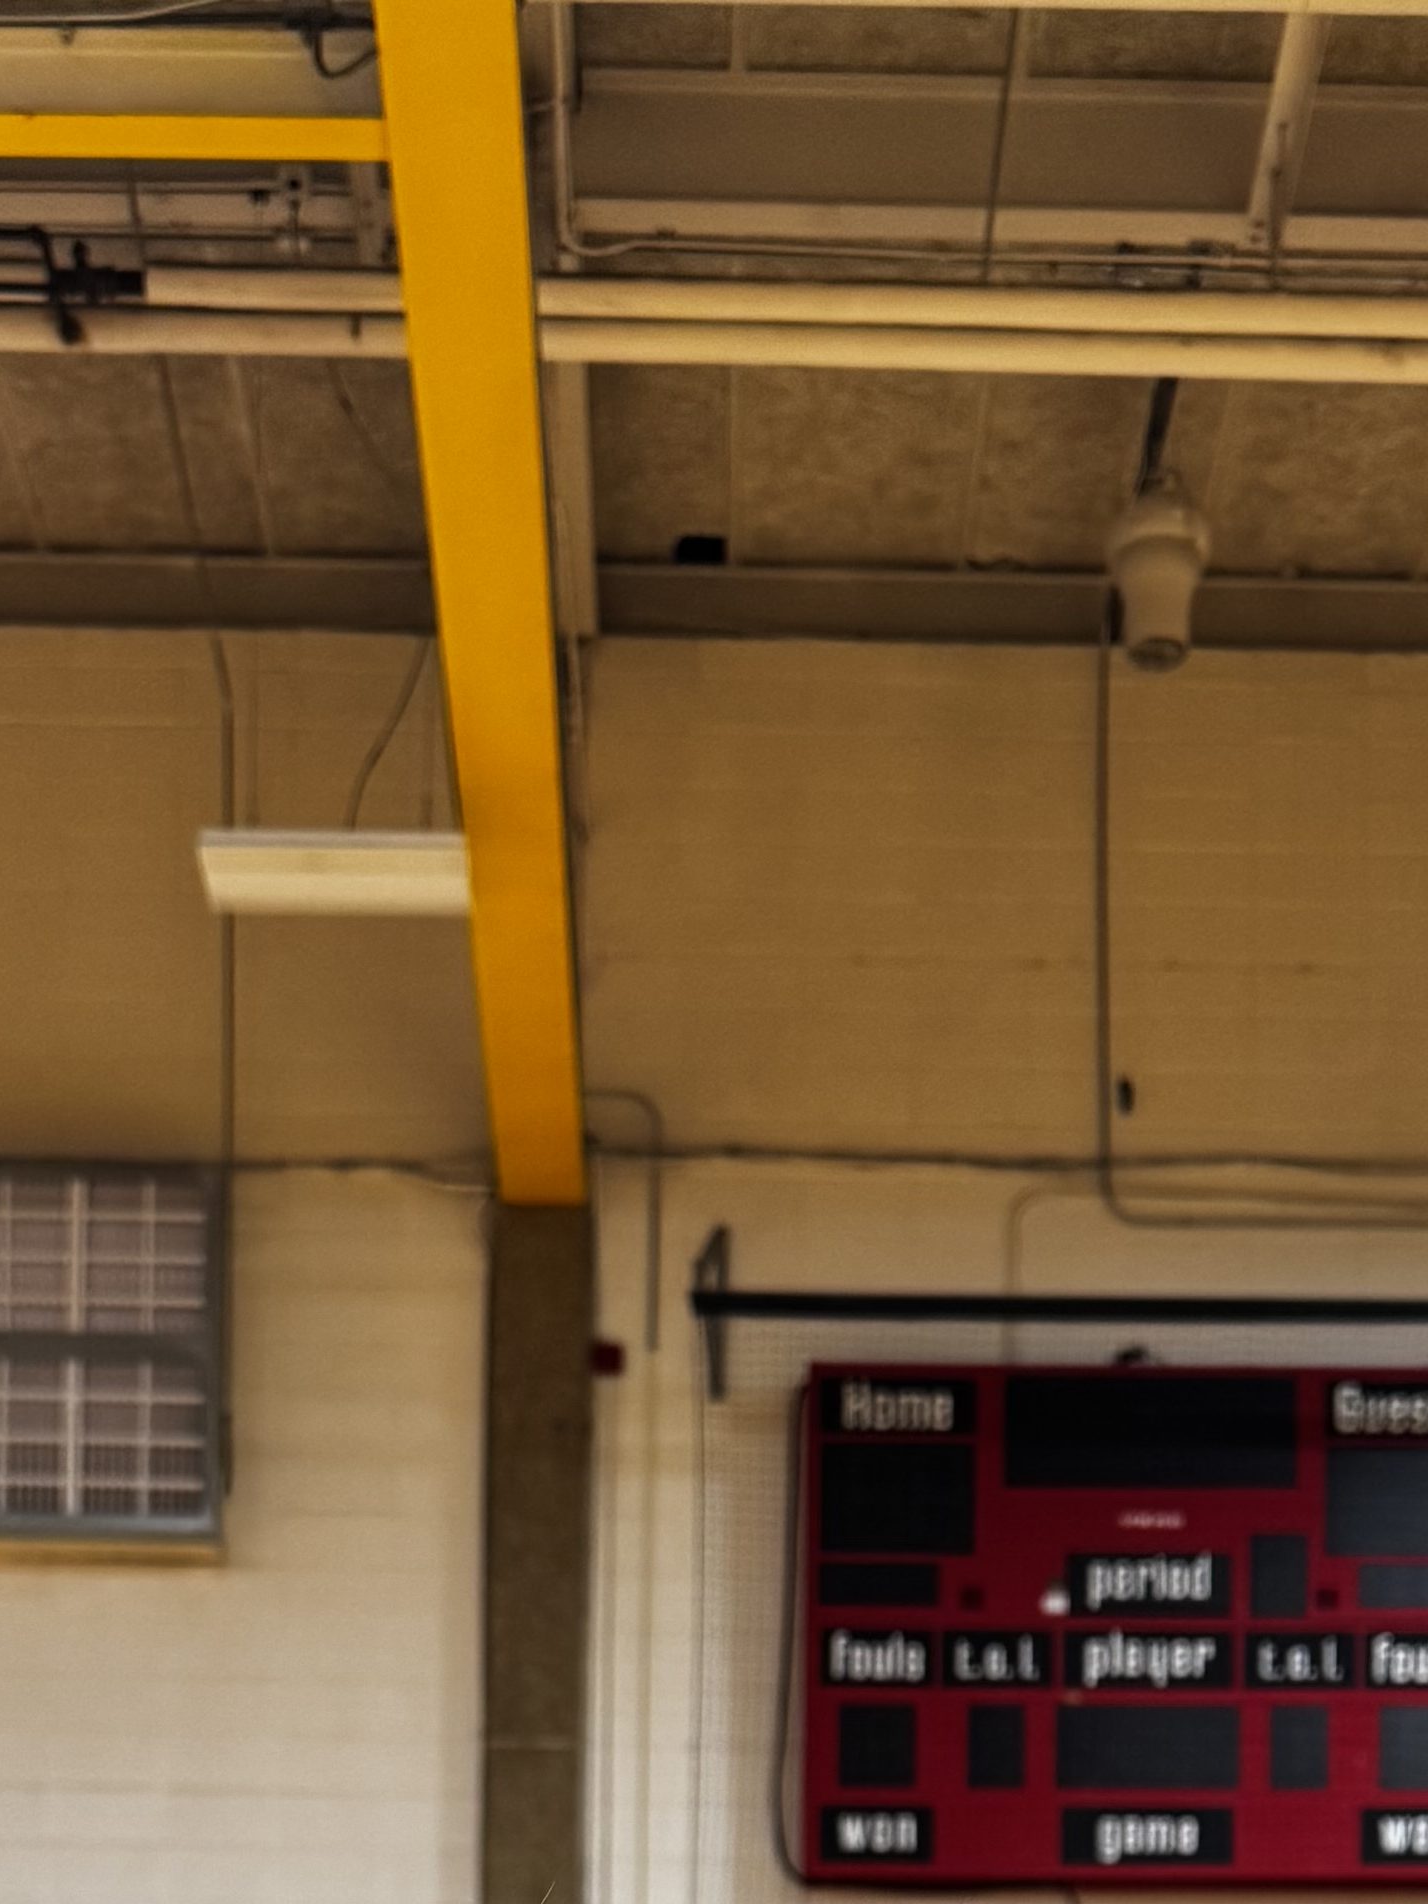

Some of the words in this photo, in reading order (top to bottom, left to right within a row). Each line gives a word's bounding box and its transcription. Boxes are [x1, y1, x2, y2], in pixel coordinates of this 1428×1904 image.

[842, 1384, 953, 1432] Home
[1087, 1554, 1213, 1610] period
[829, 1629, 926, 1682] fouls
[1083, 1628, 1217, 1688] player
[837, 1812, 918, 1852] won
[1095, 1813, 1200, 1864] game
